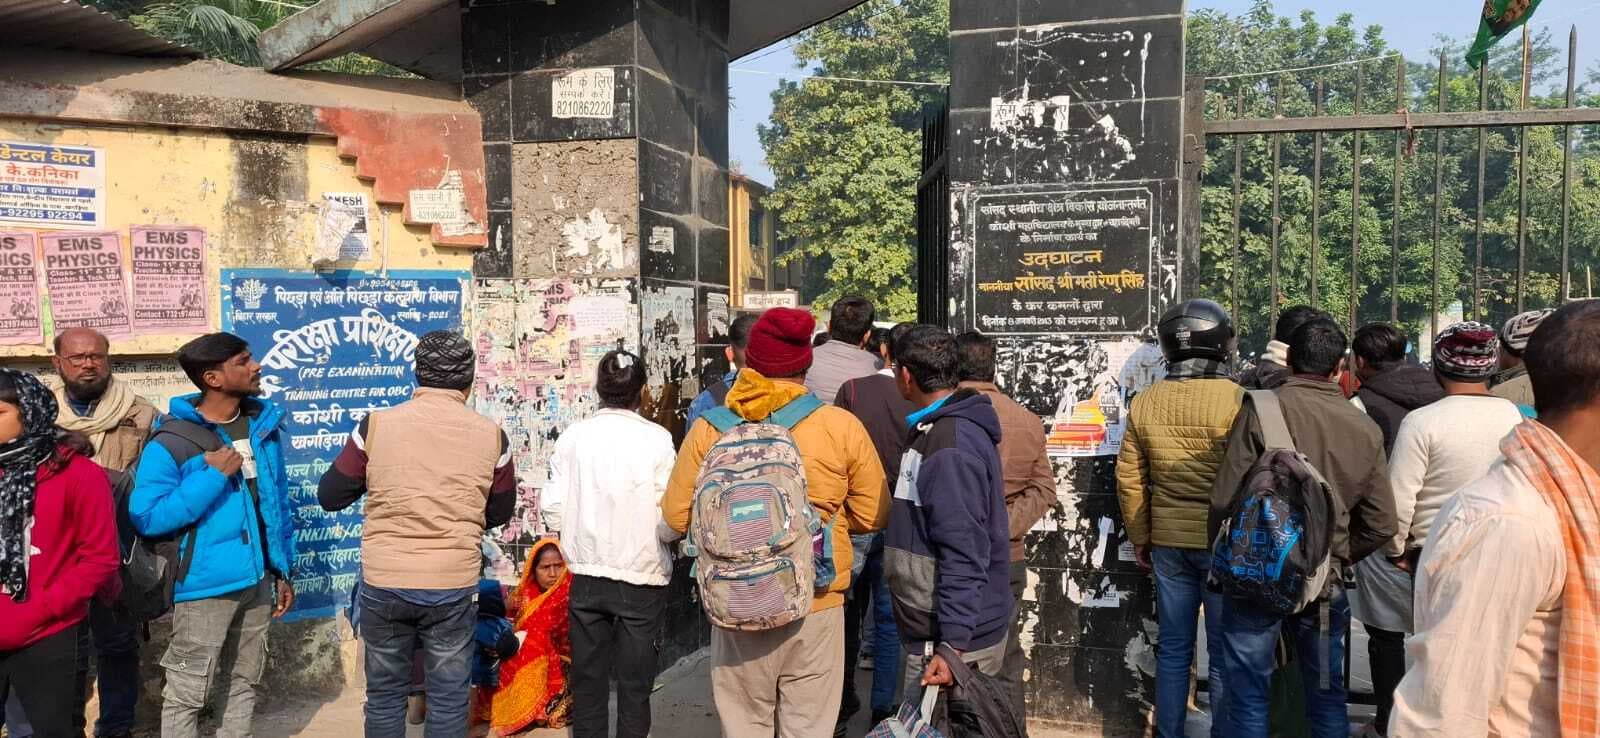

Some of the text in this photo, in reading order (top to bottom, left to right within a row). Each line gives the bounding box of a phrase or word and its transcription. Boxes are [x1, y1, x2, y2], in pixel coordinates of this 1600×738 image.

[578, 71, 588, 88] के
[556, 101, 611, 116] 8210862220
[50, 147, 92, 166] केयर
[47, 211, 83, 220] 92294
[980, 202, 1006, 217] सांसद
[1007, 200, 1045, 215] स्थानीय
[58, 237, 103, 251] EMS
[146, 232, 188, 244] EMS
[1020, 231, 1031, 243] के
[1085, 232, 1098, 242] का
[47, 252, 118, 268] PHYSICS
[134, 246, 201, 260] PHYSICS
[1013, 271, 1056, 294] सांसद
[1098, 270, 1121, 294] रेणु
[1120, 268, 1145, 290] सिंह
[274, 286, 308, 309] पिछड़ा
[310, 288, 322, 308] एवं
[346, 286, 383, 308] पिछड़ा
[428, 286, 460, 305] विभाग
[1012, 299, 1022, 311] के
[1025, 301, 1044, 312] कर
[1082, 300, 1104, 313] द्वारा
[1055, 313, 1066, 326] को
[298, 364, 405, 381] (PRE EXAMINATION
[284, 389, 329, 401] TRAINING
[331, 388, 367, 399] CENTRE
[369, 388, 386, 398] FOR
[292, 404, 345, 426] कोशी
[291, 430, 349, 451] खगड़िया
